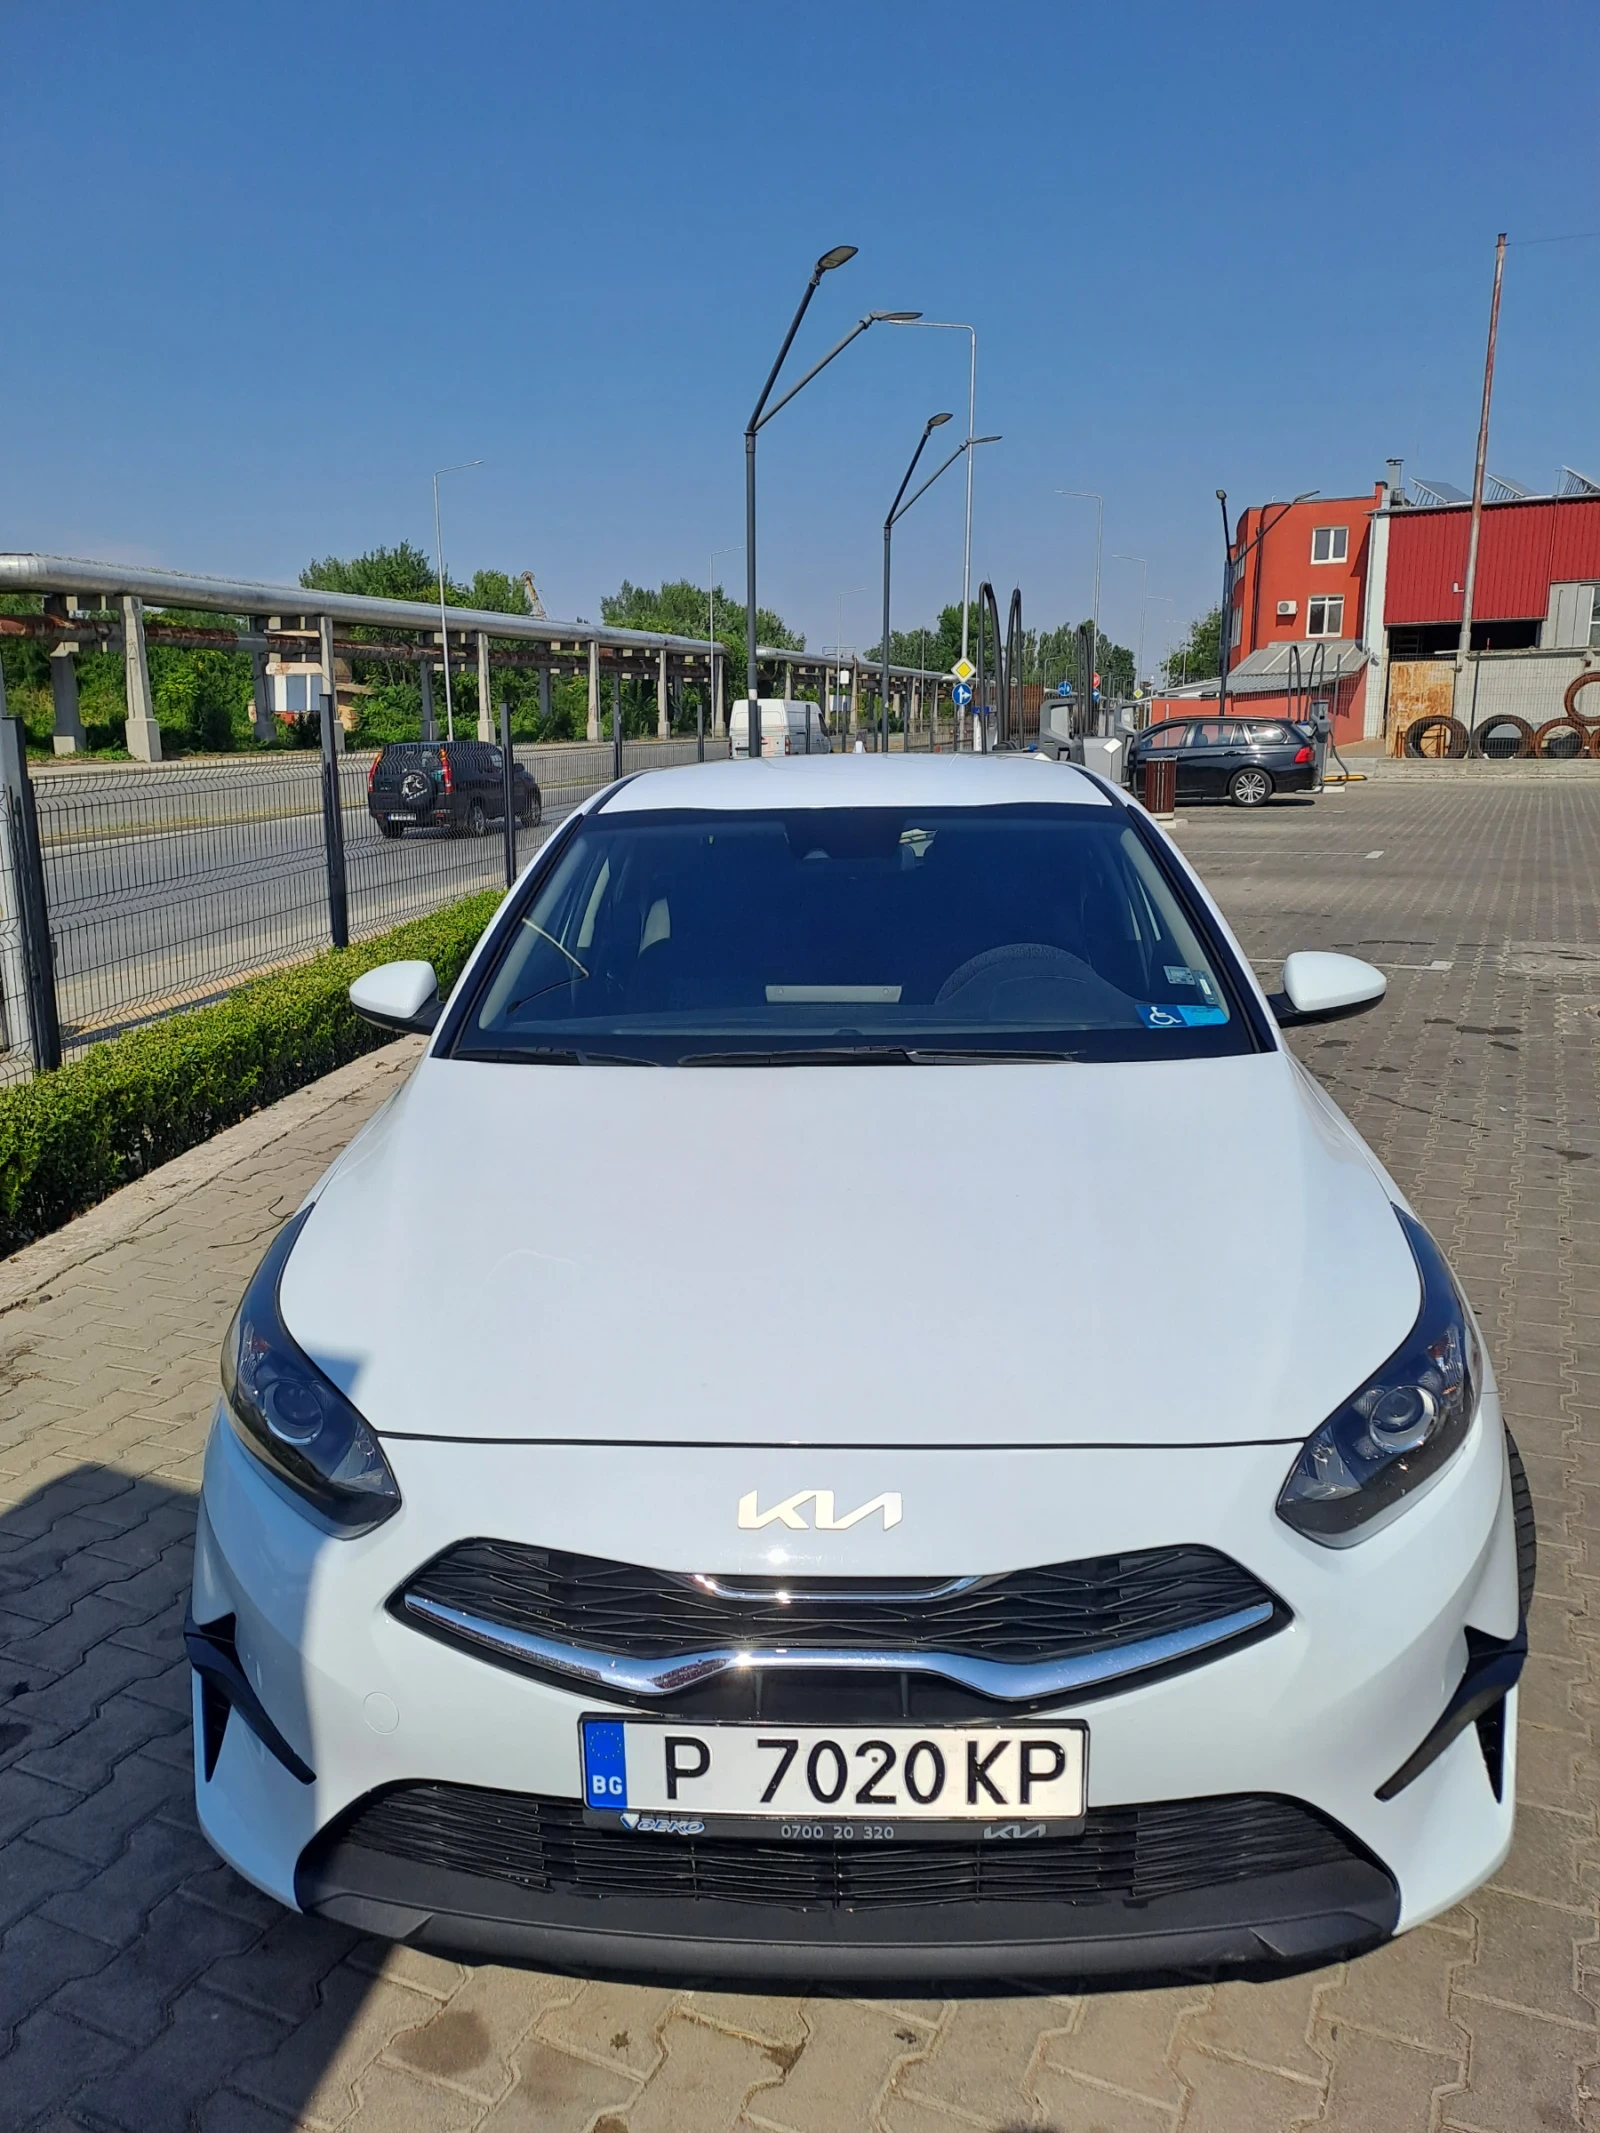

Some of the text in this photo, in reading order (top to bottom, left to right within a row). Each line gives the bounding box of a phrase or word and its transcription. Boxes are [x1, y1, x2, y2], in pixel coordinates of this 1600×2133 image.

[737, 1489, 903, 1532] KIA
[665, 1736, 711, 1800] P
[592, 1775, 623, 1795] BG
[781, 1825, 894, 1839] 0700 20 320
[984, 1824, 1047, 1839] KIA
